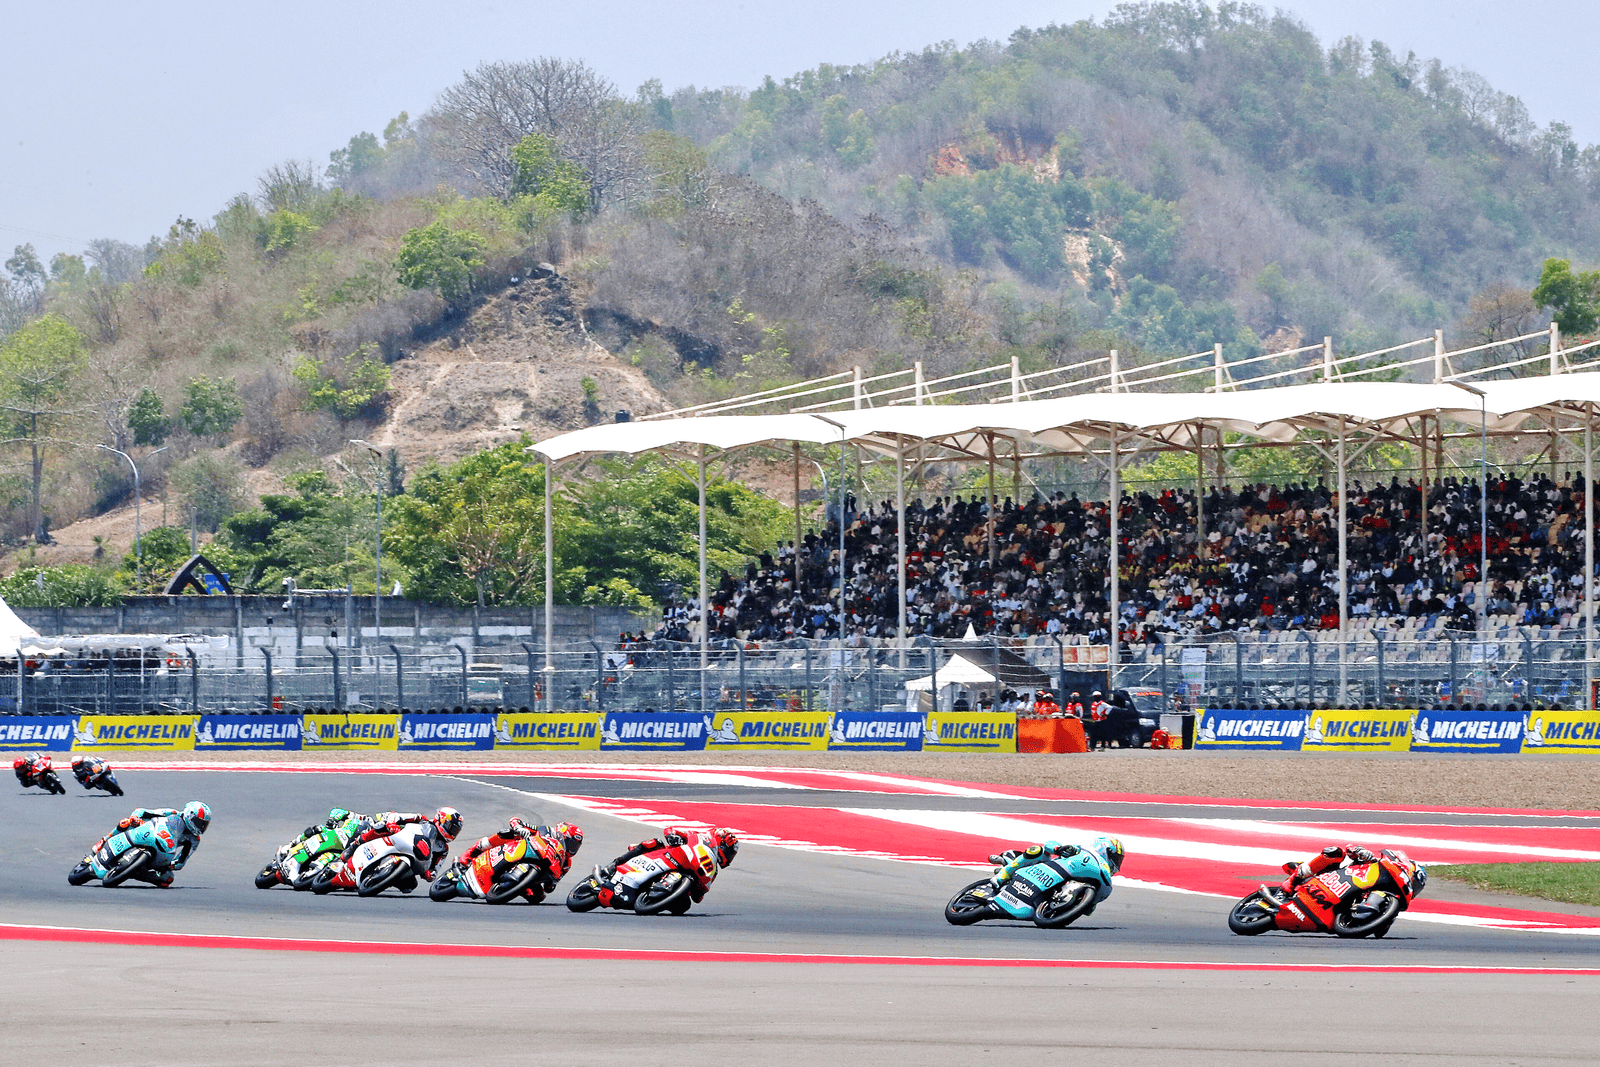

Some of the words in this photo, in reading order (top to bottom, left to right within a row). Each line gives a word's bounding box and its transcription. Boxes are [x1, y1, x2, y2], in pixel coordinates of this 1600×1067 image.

[99, 724, 192, 739] MICHELIN
[215, 723, 300, 739] MICHELIN
[321, 723, 395, 739] MICHELIN
[413, 722, 492, 739] MICHELIN
[512, 722, 597, 739] MICHELIN
[620, 721, 703, 739] MICHELIN
[740, 721, 828, 739] MICHELIN
[846, 720, 922, 739] MICHELIN
[940, 722, 1014, 740] MICHELIN
[1217, 719, 1304, 738] MICHELIN
[1325, 720, 1410, 738] MICHELIN
[1431, 721, 1523, 740] MICHELIN
[1025, 865, 1054, 888] LEOPARD
[1287, 902, 1305, 922] MOTUL
